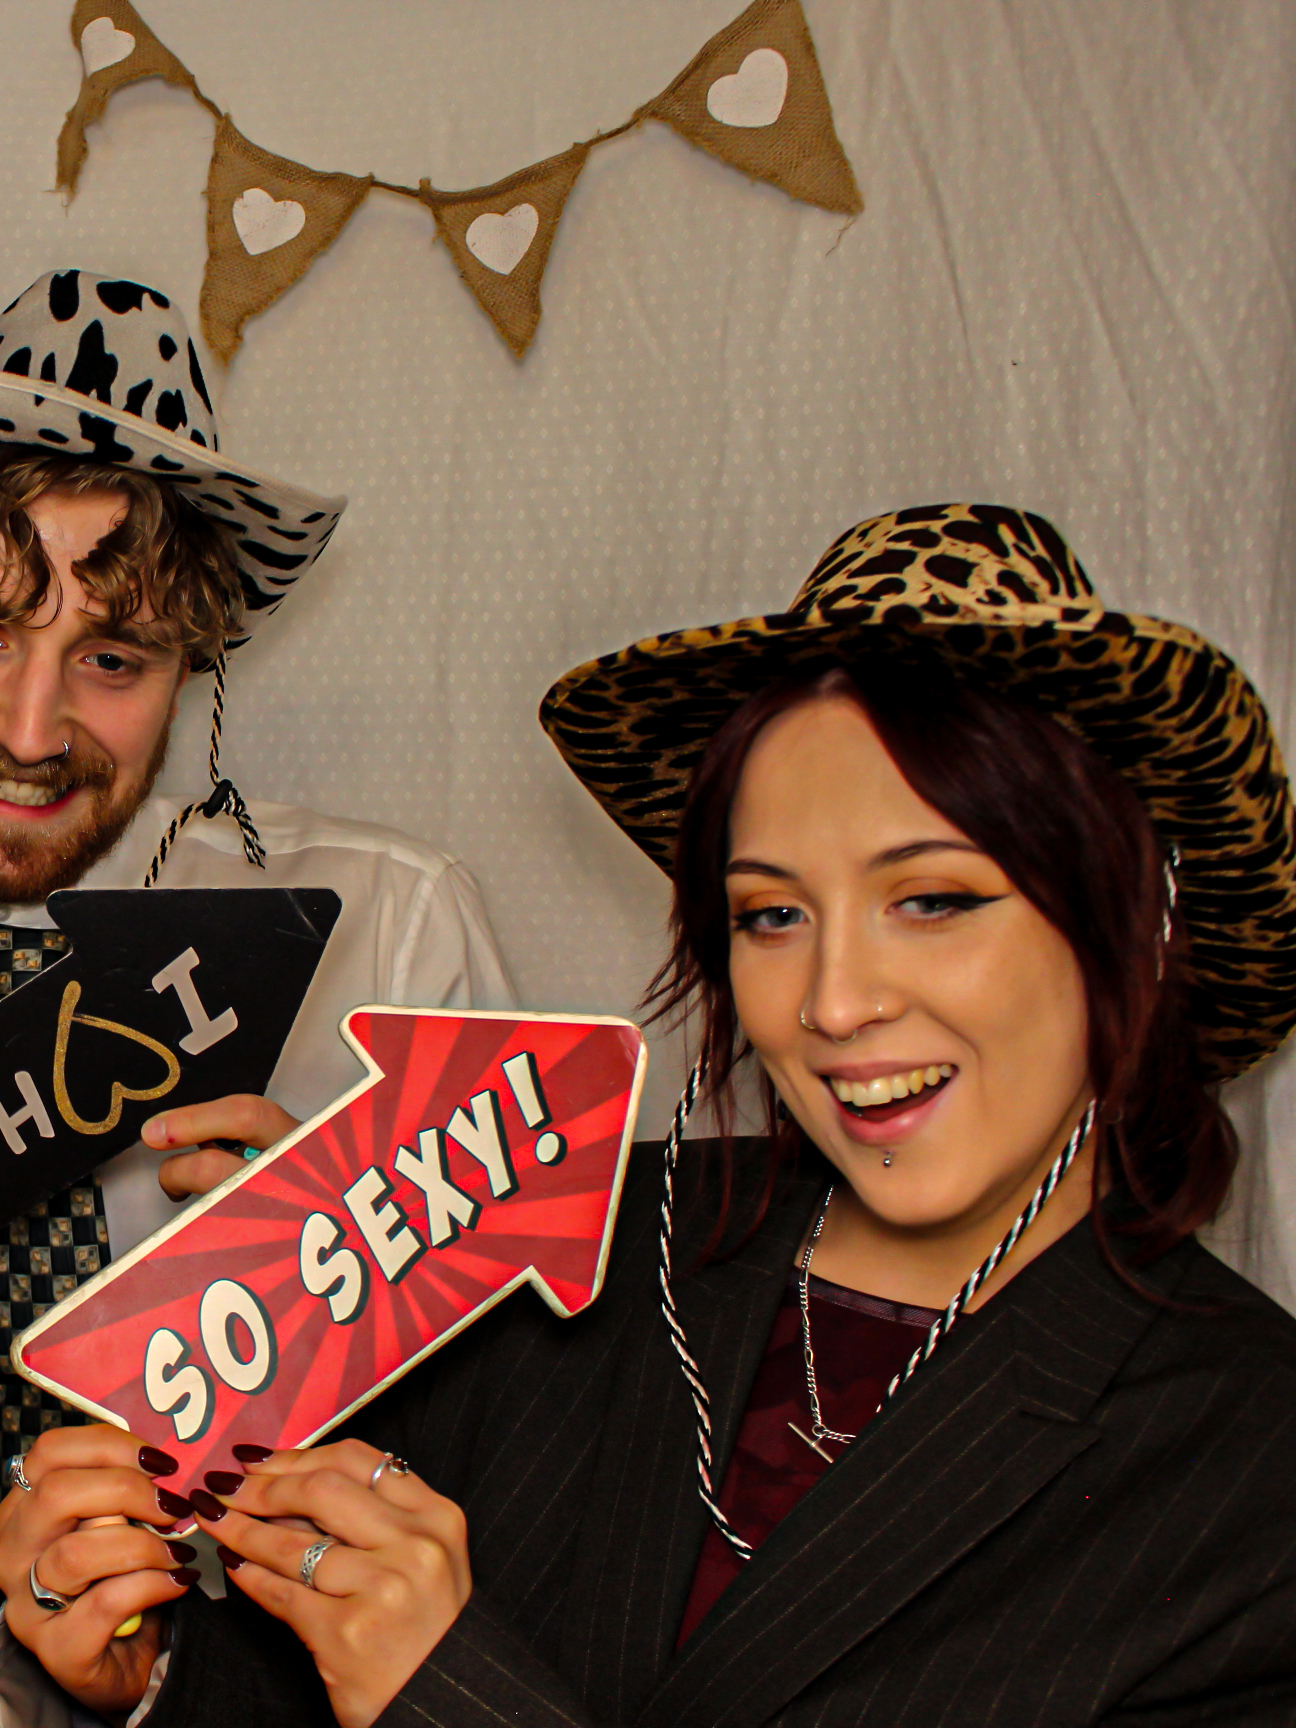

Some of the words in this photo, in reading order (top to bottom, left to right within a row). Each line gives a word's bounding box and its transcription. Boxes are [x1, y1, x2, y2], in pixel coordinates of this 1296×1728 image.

[151, 946, 239, 1056] I
[144, 1278, 277, 1442] SO
[299, 1051, 567, 1324] SEXY!
